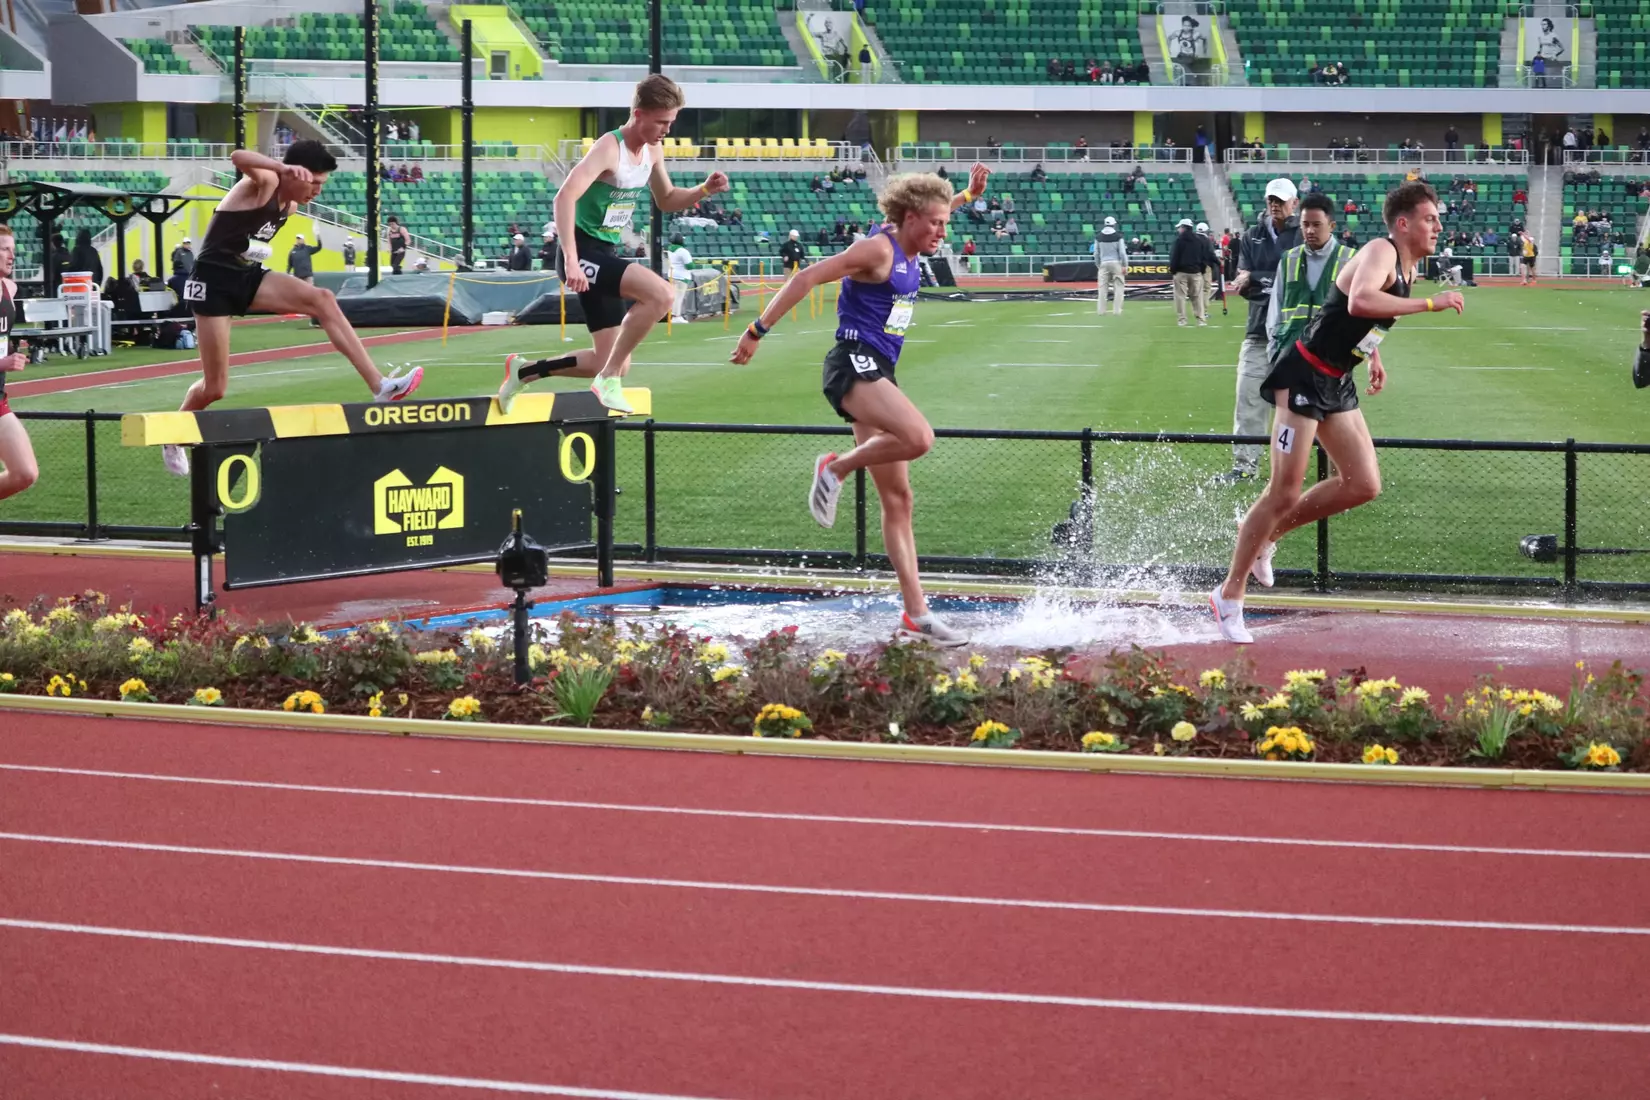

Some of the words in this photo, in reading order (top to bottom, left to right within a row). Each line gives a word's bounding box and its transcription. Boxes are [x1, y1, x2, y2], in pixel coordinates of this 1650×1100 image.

[186, 282, 203, 299] 12
[855, 354, 871, 370] 9
[364, 403, 471, 426] OREGON
[1278, 428, 1289, 450] 4
[560, 432, 596, 481] O
[217, 454, 259, 509] O
[388, 486, 451, 513] HAYWARD
[403, 510, 437, 532] FIELD
